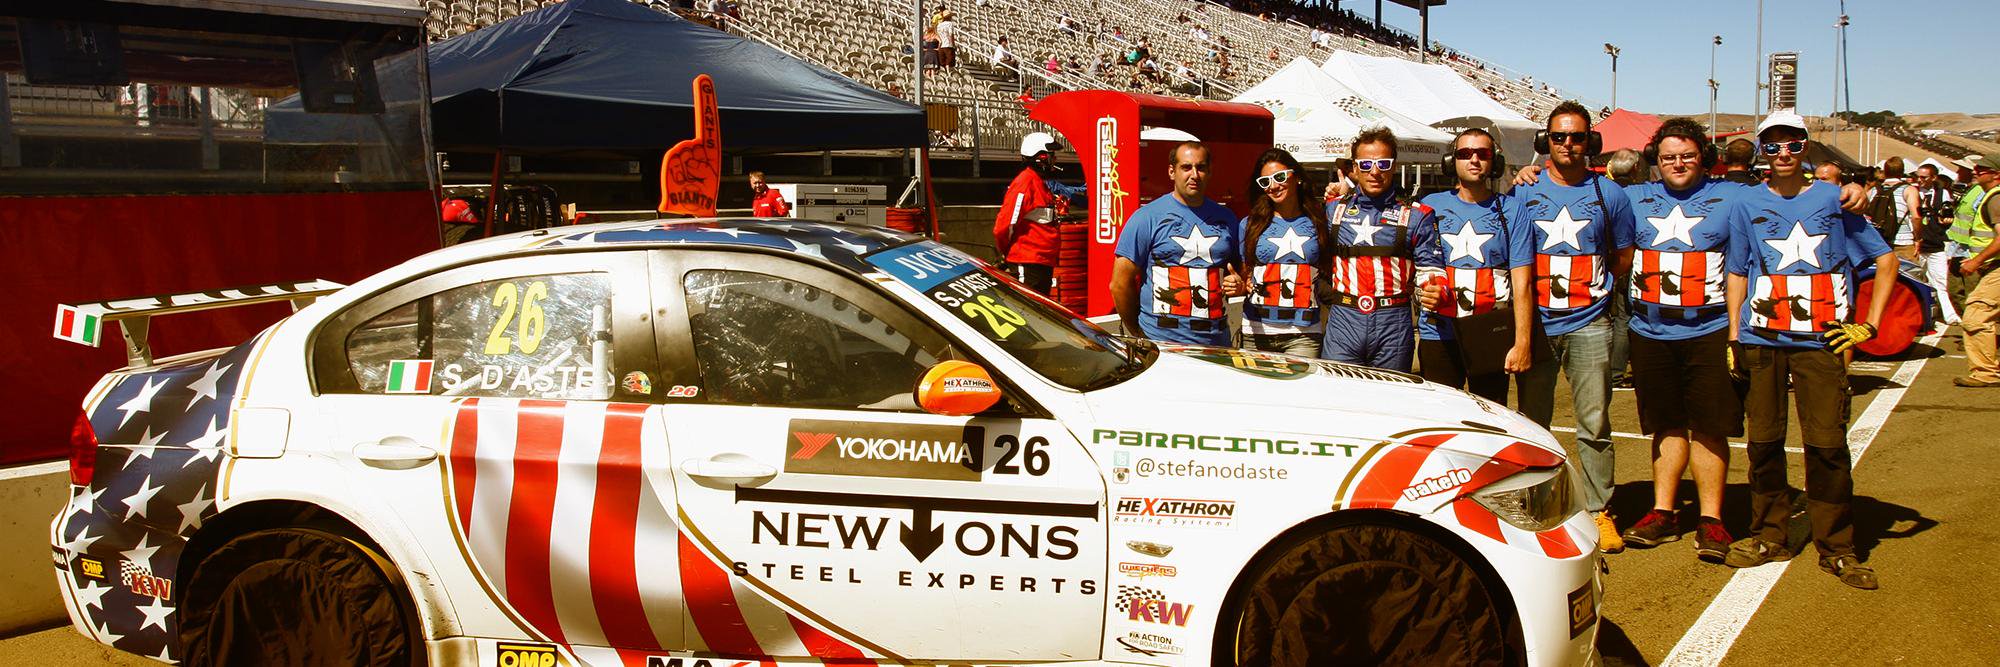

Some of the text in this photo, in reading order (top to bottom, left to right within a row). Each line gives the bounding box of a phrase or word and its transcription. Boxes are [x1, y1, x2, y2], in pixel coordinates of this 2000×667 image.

[702, 84, 715, 149] GIANTS
[1100, 124, 1111, 237] WIECHERS
[669, 191, 714, 210] GIANTS
[948, 273, 998, 298] D'ASTE
[484, 281, 548, 355] 26
[961, 294, 1027, 339] 26
[481, 365, 594, 394] D'ASTE
[667, 385, 699, 398] 26
[944, 379, 992, 388] HEXATHRON
[835, 436, 974, 464] YOKOHAMA
[993, 434, 1050, 476] 26
[1136, 458, 1288, 480] @stefanodaste
[1403, 469, 1472, 501] pakelo
[1116, 498, 1236, 516] HEXATHRON
[82, 561, 104, 576] OMP
[732, 561, 1097, 595] STEEL EXPERTS
[131, 573, 171, 601] KW
[1128, 598, 1195, 627] KW
[1141, 633, 1172, 645] ACTION
